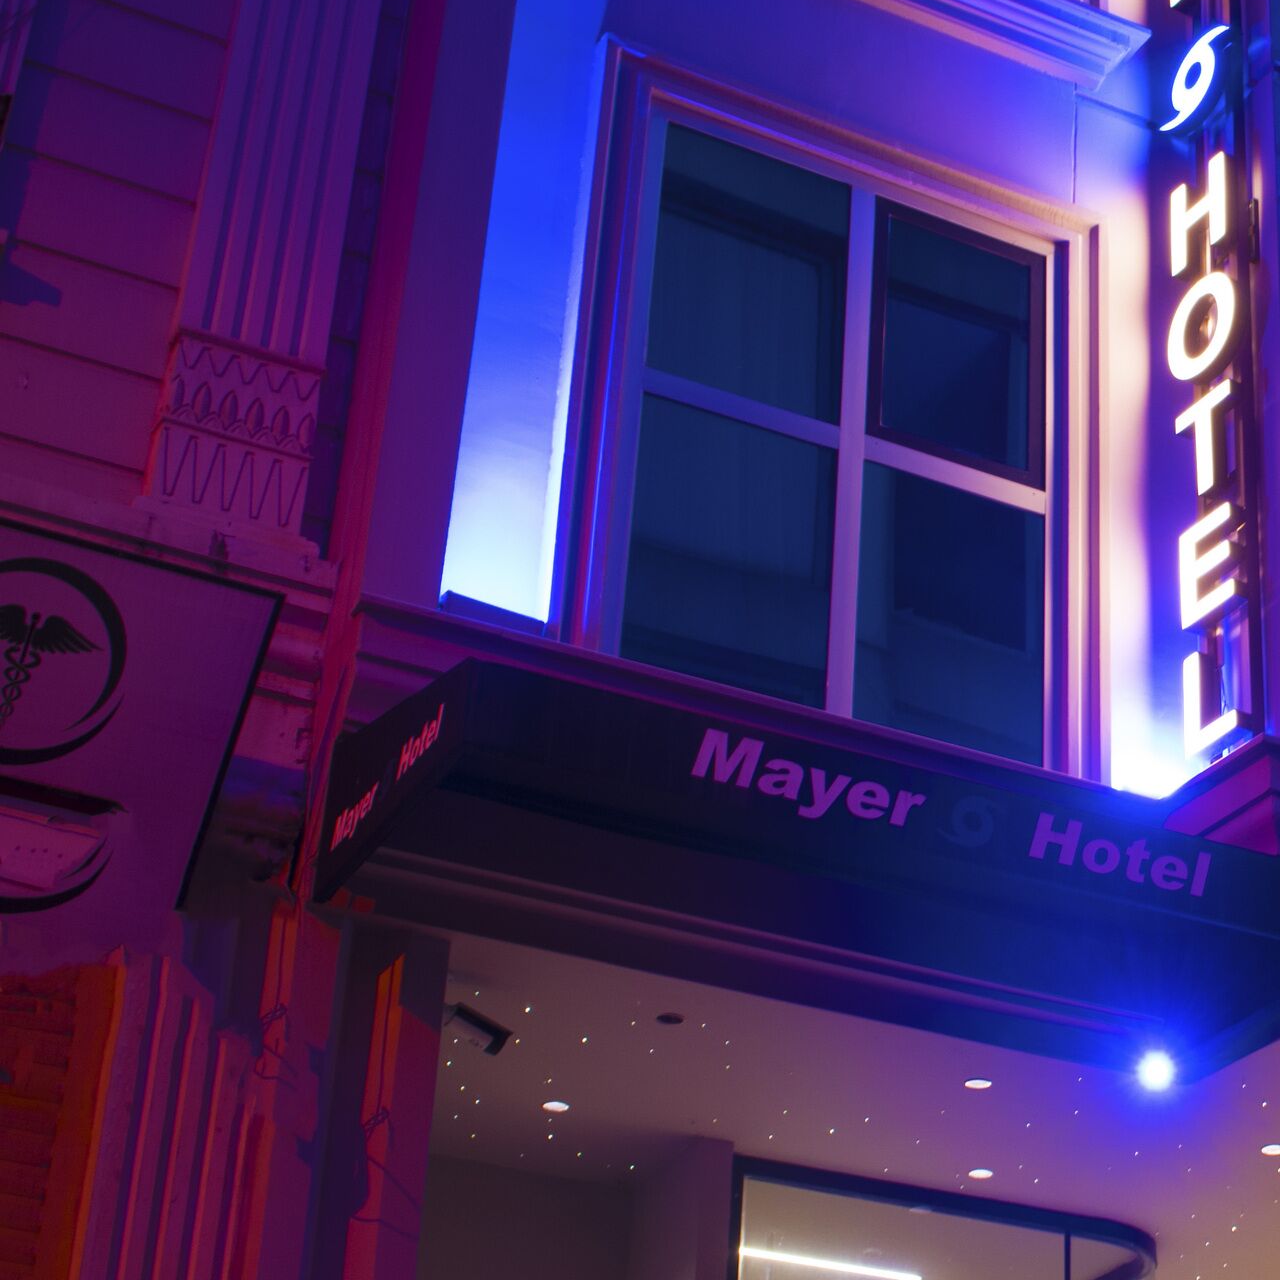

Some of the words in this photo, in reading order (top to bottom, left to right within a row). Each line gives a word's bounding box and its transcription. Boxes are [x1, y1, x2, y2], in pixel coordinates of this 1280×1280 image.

[1167, 150, 1238, 758] HOTEL
[328, 780, 380, 853] Mayer
[394, 703, 445, 784] Hotel
[691, 728, 926, 828] Mayer
[1028, 812, 1212, 897] Hotel
